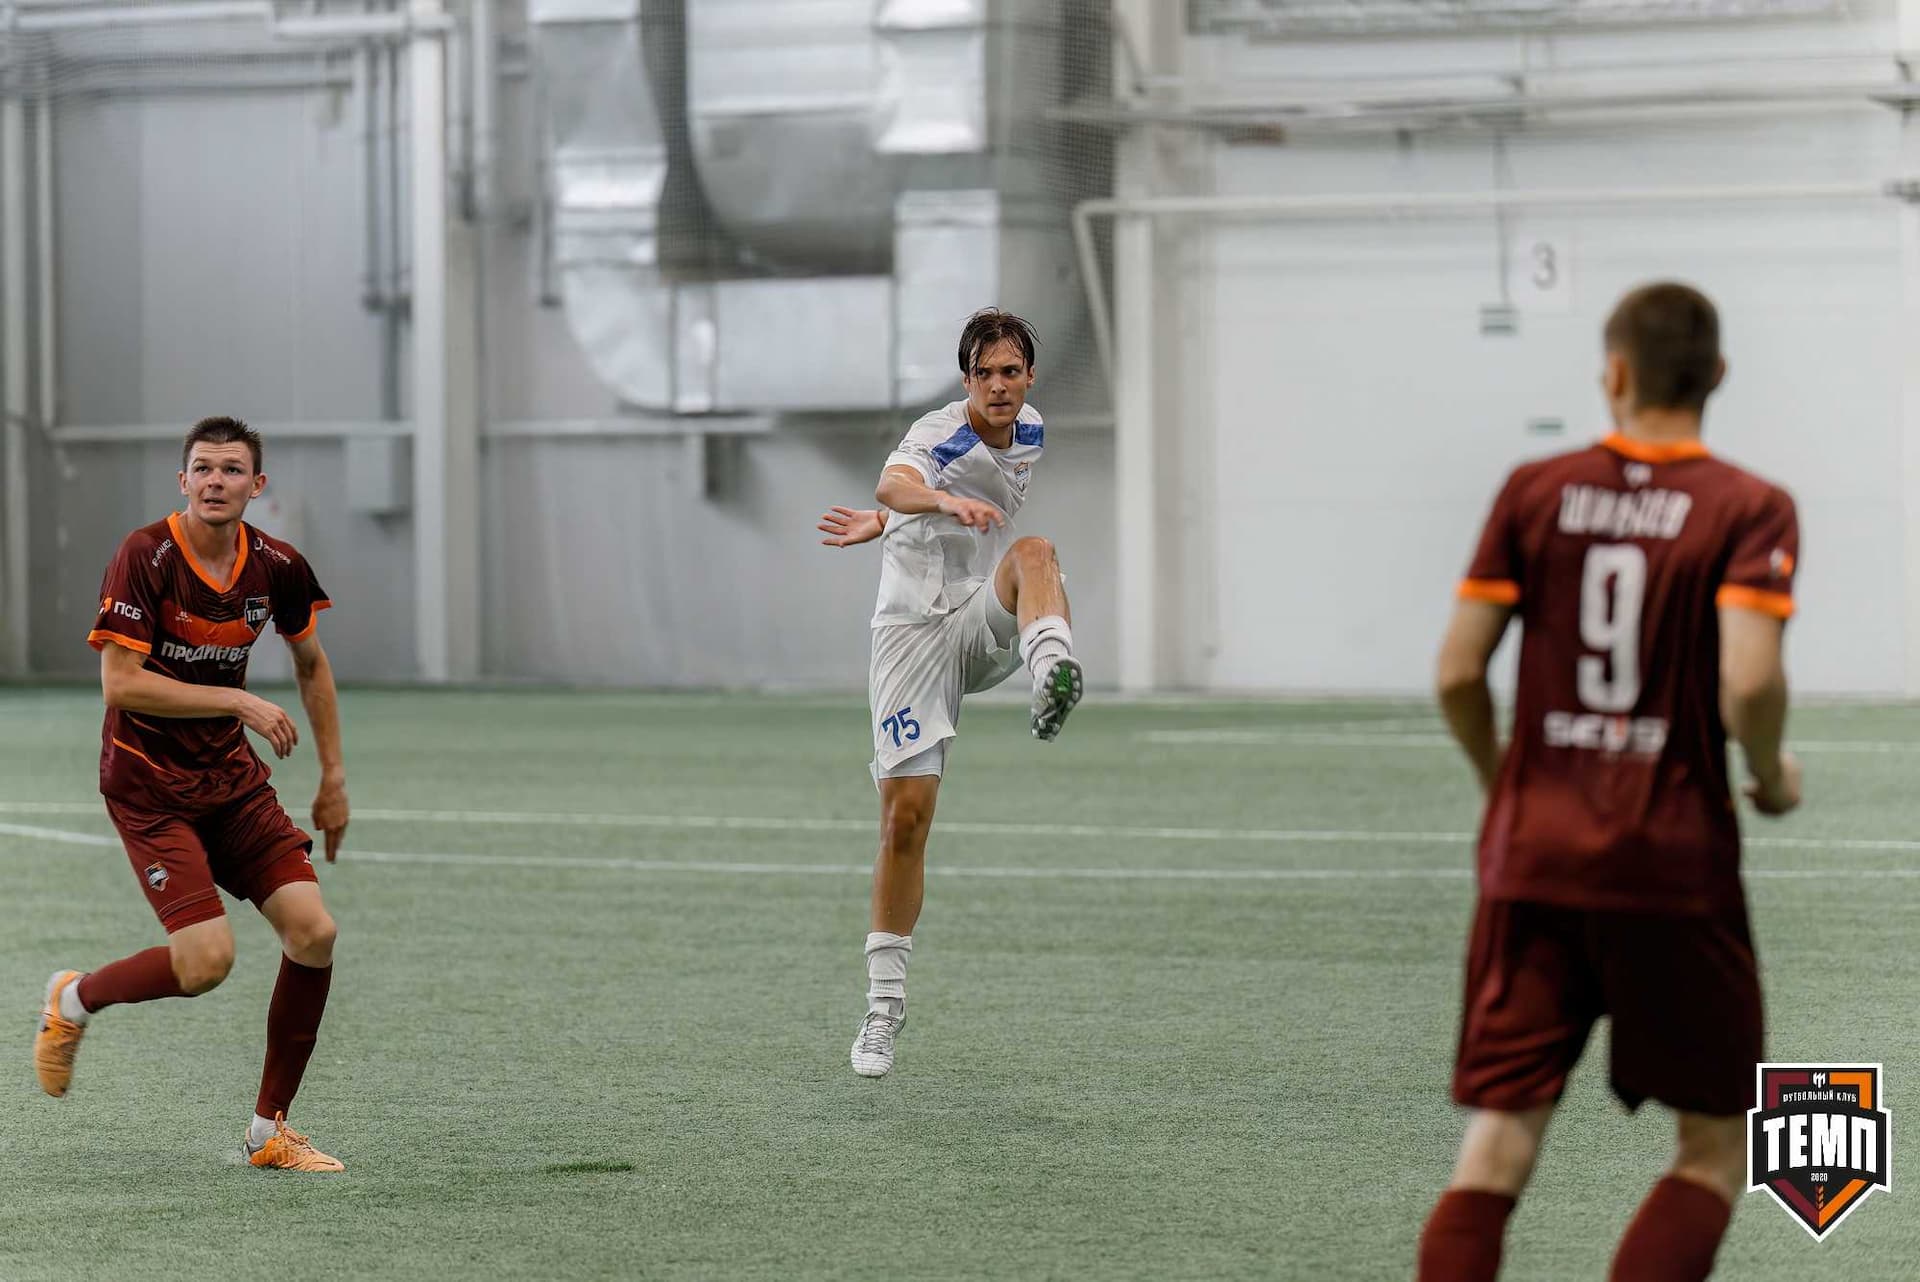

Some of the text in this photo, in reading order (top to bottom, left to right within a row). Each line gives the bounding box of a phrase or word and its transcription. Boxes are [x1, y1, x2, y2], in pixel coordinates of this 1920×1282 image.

[1531, 242, 1557, 290] 3
[114, 601, 142, 620] ПСБ
[1577, 543, 1647, 711] 9
[881, 706, 920, 748] 75
